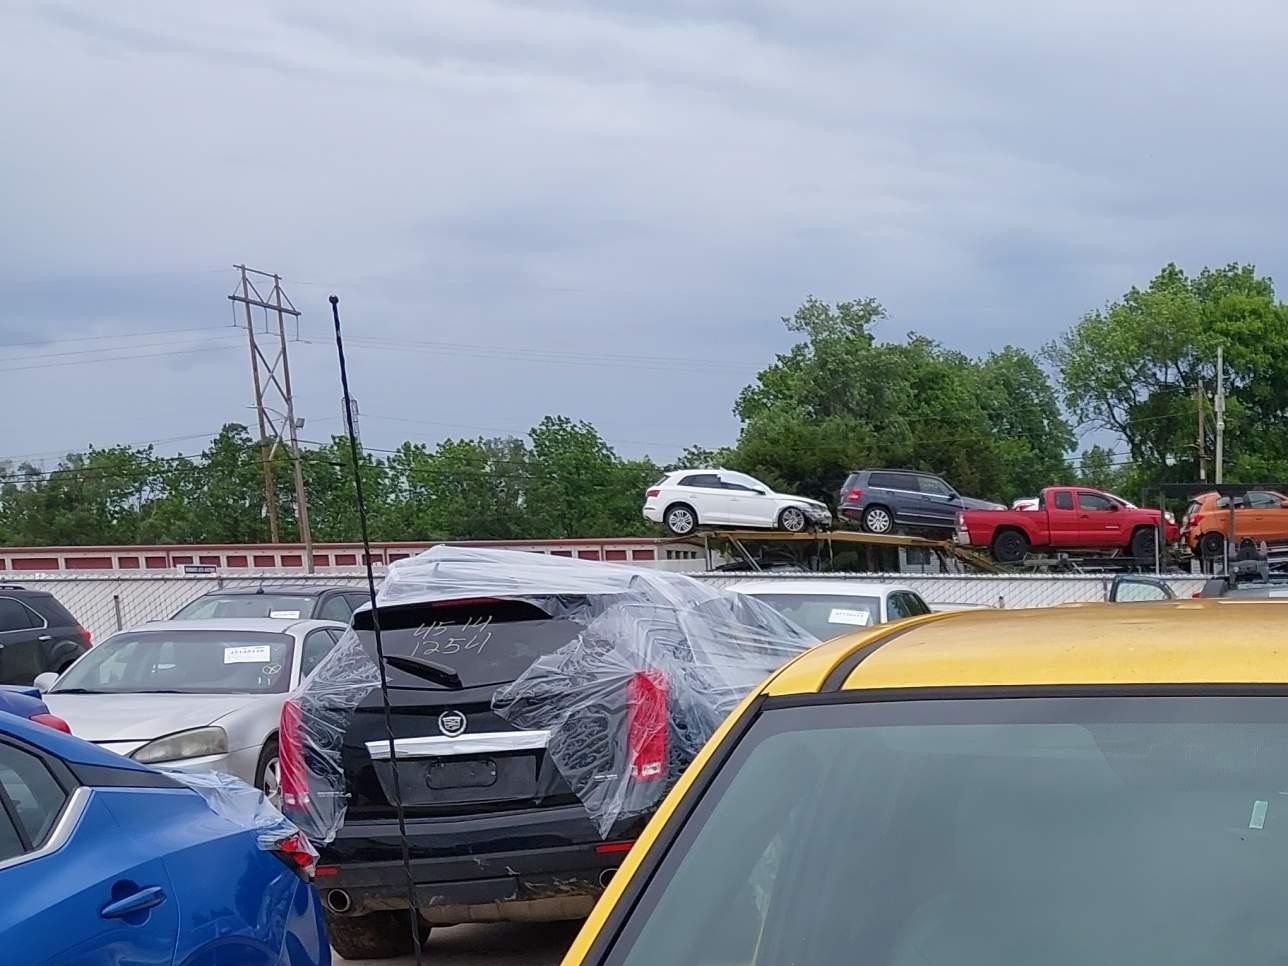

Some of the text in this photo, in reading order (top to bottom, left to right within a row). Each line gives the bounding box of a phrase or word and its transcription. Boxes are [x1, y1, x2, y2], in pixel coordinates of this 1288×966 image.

[413, 615, 493, 640] 45 14
[411, 632, 492, 657] 1254
